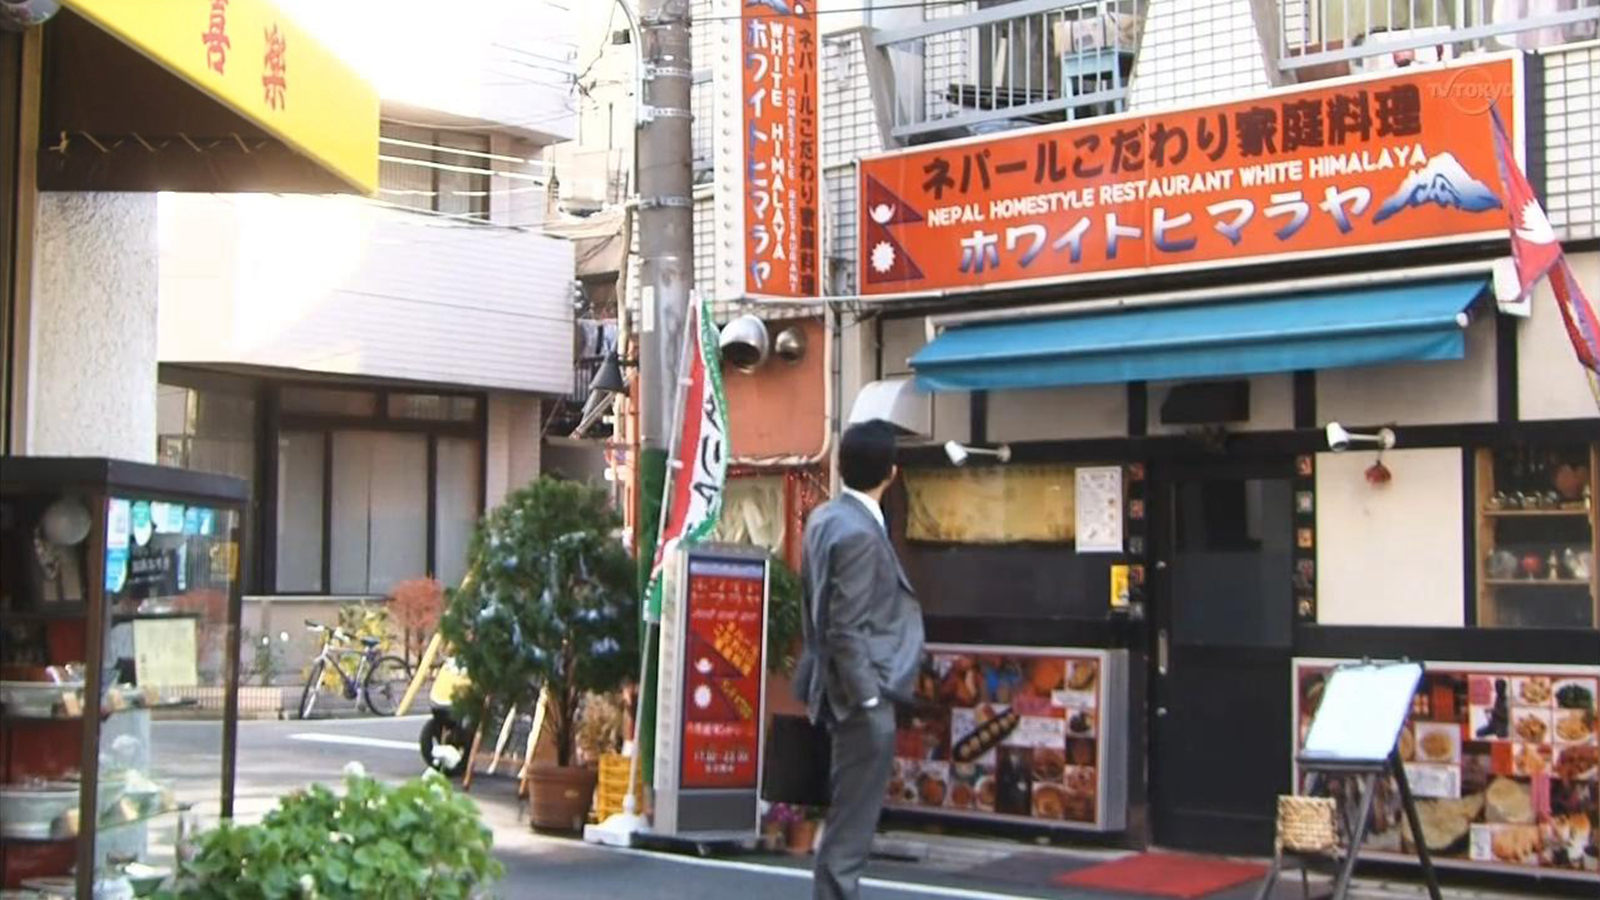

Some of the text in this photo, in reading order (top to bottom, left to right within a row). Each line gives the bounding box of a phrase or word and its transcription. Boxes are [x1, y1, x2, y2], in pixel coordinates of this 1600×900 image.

[747, 19, 771, 289] ホワイトヒマラヤ
[770, 21, 786, 260] WHITE HIMALAYA
[922, 84, 1421, 200] ネパールこだわり家庭料理
[928, 143, 1427, 227] NEPAL HOMESTYLE RESTAURANT WHITE HIMALAYA
[959, 185, 1371, 274] ホワイトヒマラヤ
